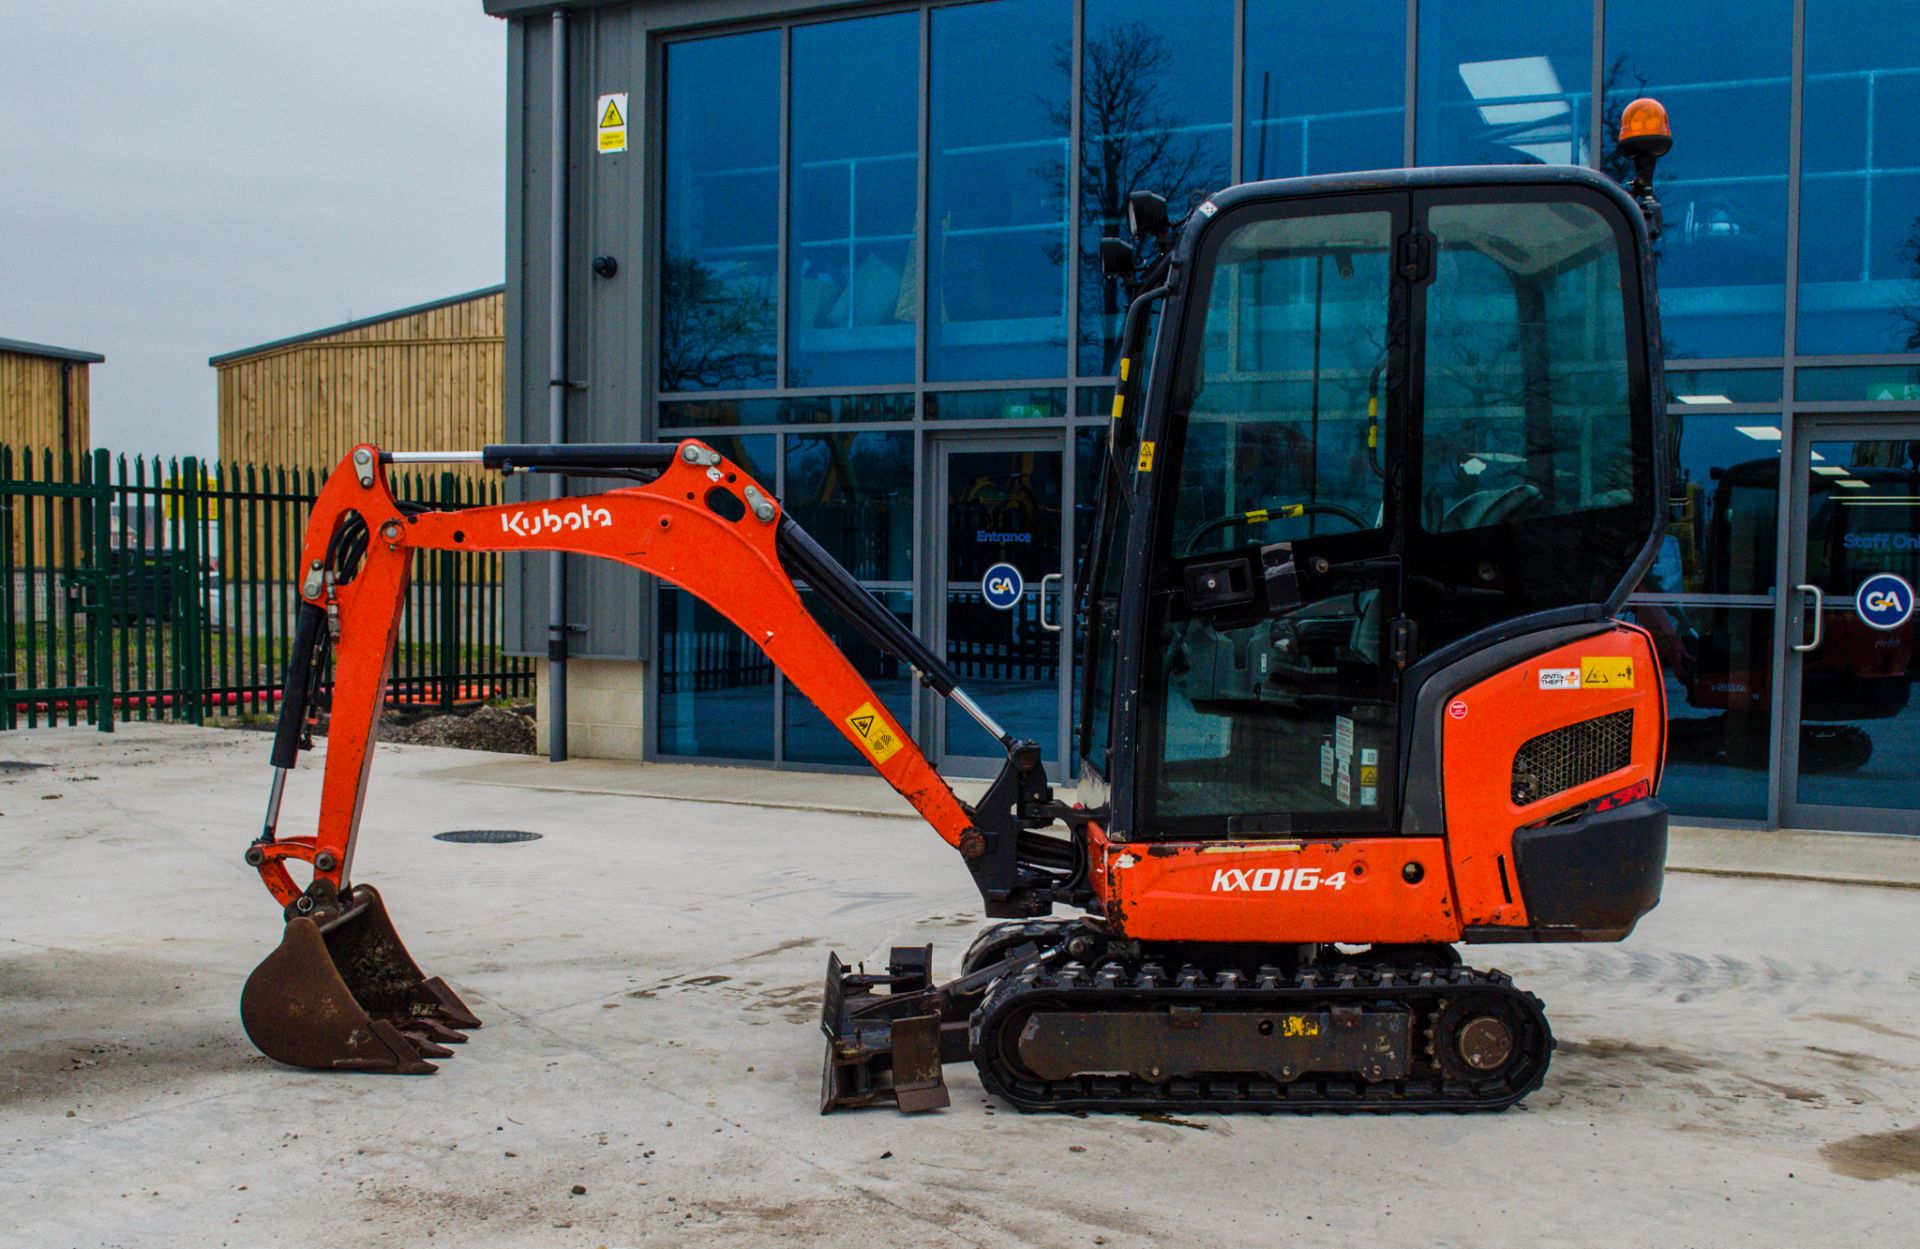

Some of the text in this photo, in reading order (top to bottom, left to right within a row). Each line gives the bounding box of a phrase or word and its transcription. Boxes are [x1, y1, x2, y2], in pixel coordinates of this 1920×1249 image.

[501, 503, 613, 537] Kubota
[977, 530, 1032, 543] Entrance
[1843, 533, 1890, 549] Staff
[989, 577, 1016, 595] GA
[1865, 591, 1903, 612] GA
[1211, 868, 1346, 892] KX016-4
